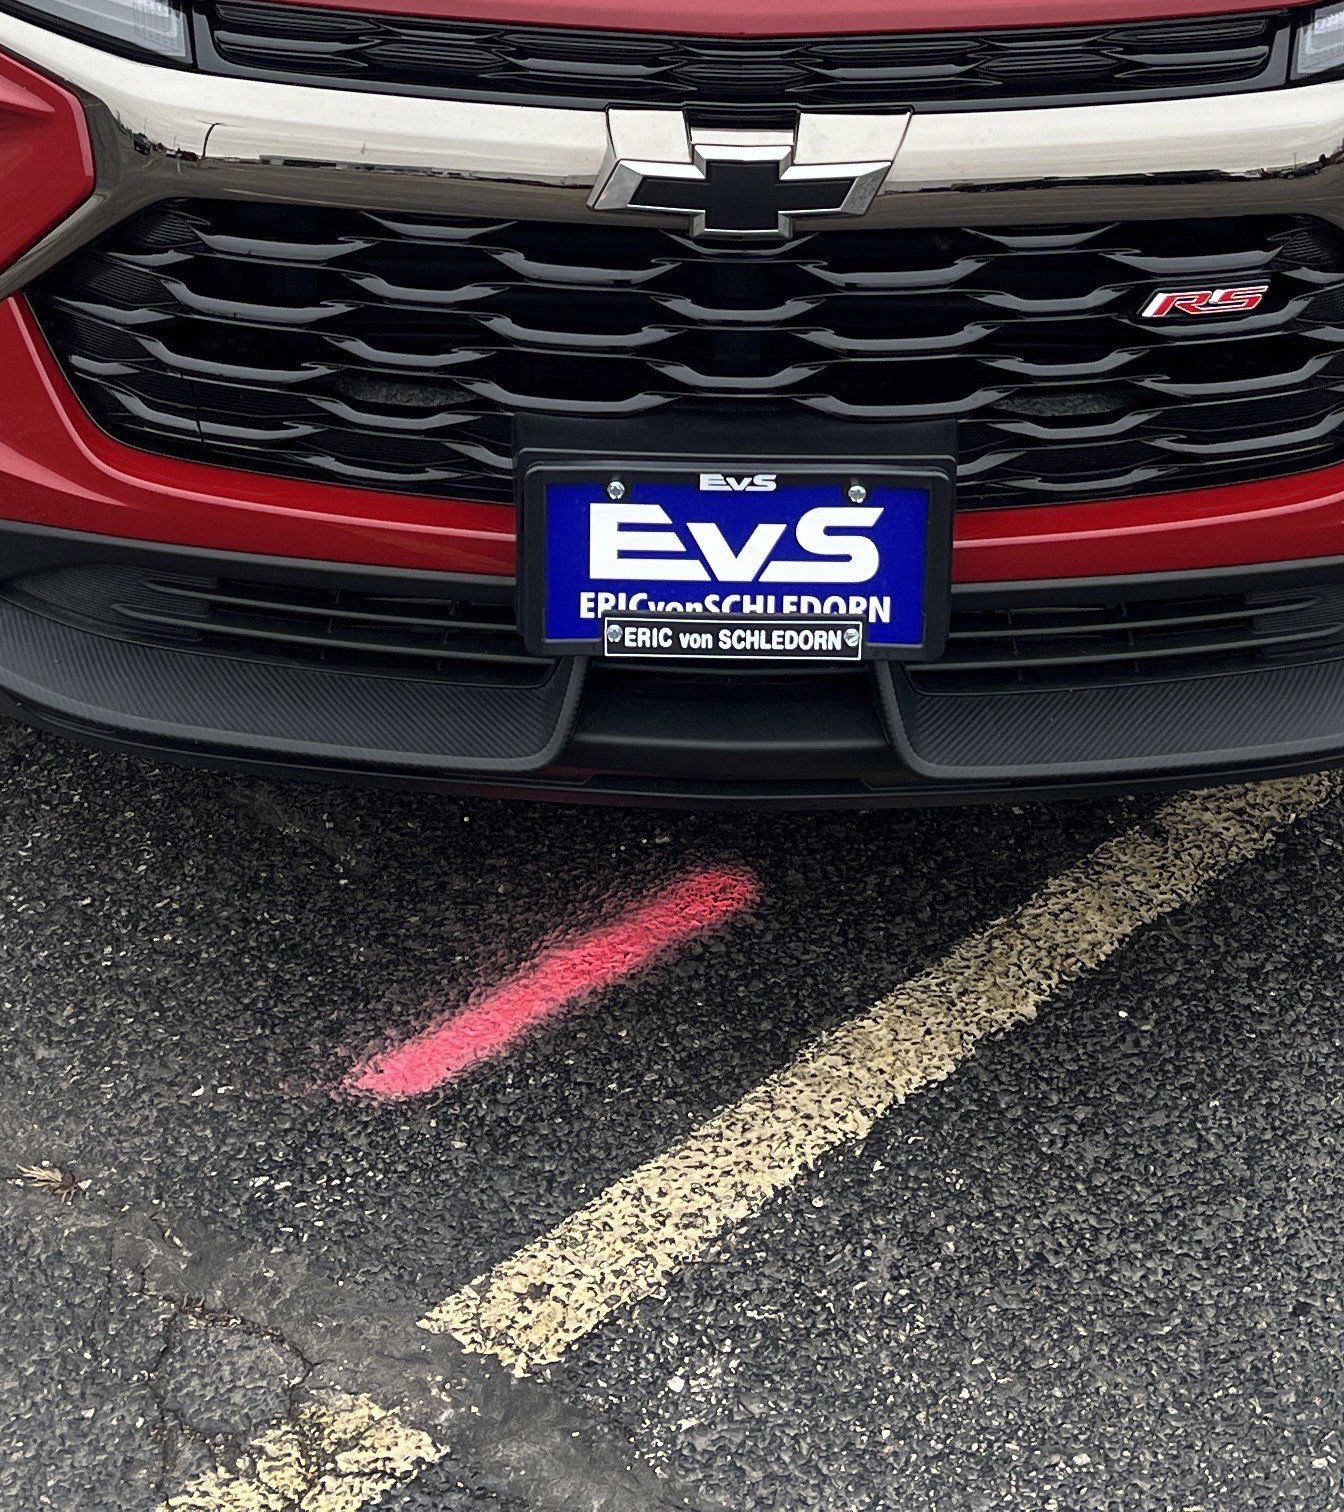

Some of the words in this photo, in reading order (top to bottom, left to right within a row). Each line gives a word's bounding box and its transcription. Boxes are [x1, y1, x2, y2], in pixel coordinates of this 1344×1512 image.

[1141, 285, 1269, 317] RS
[624, 626, 673, 648] ERIC
[679, 632, 713, 649] von
[718, 628, 842, 650] SCHLEDORN
